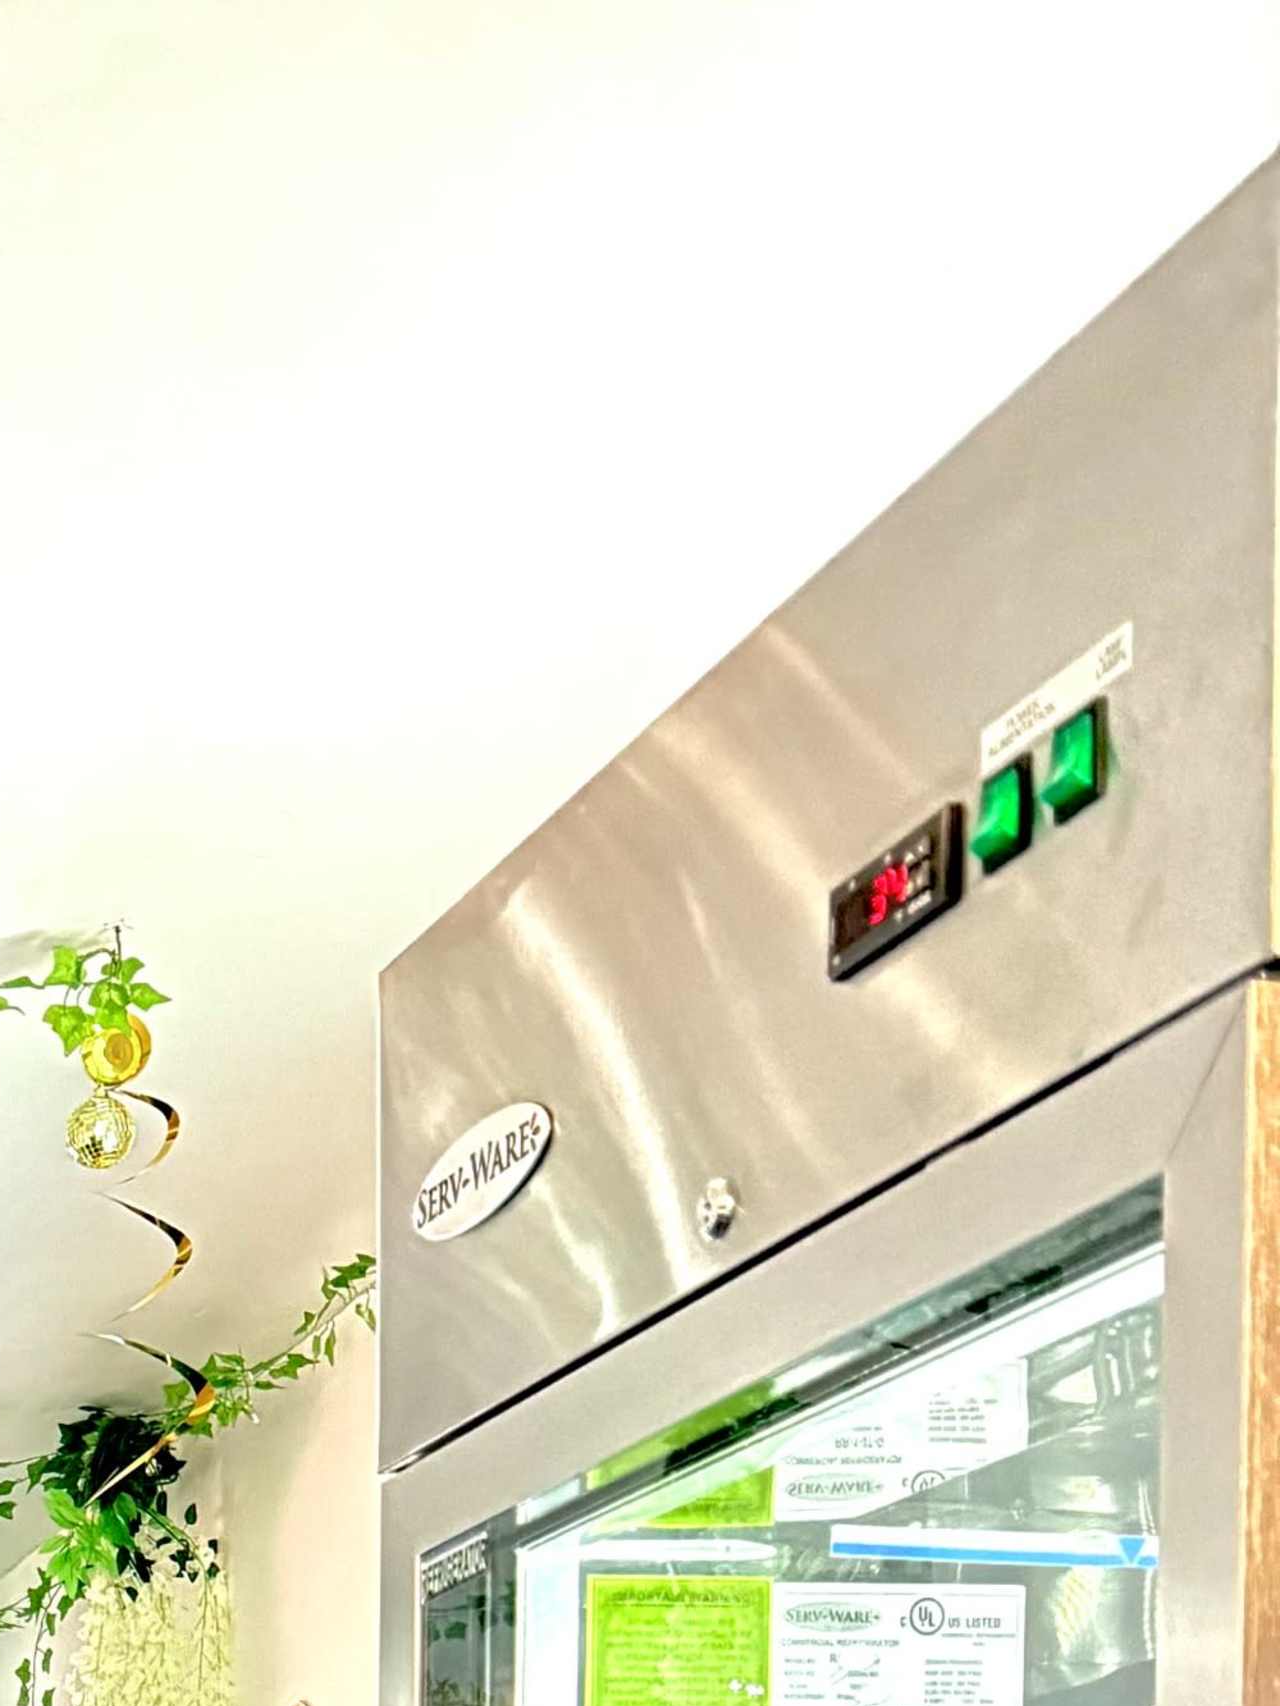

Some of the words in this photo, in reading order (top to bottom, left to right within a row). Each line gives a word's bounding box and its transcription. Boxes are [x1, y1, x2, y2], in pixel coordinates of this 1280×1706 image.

[417, 1119, 531, 1229] SERV-WARE
[918, 1605, 936, 1628] UL
[948, 1617, 961, 1629] US
[965, 1618, 1001, 1630] LISTED
